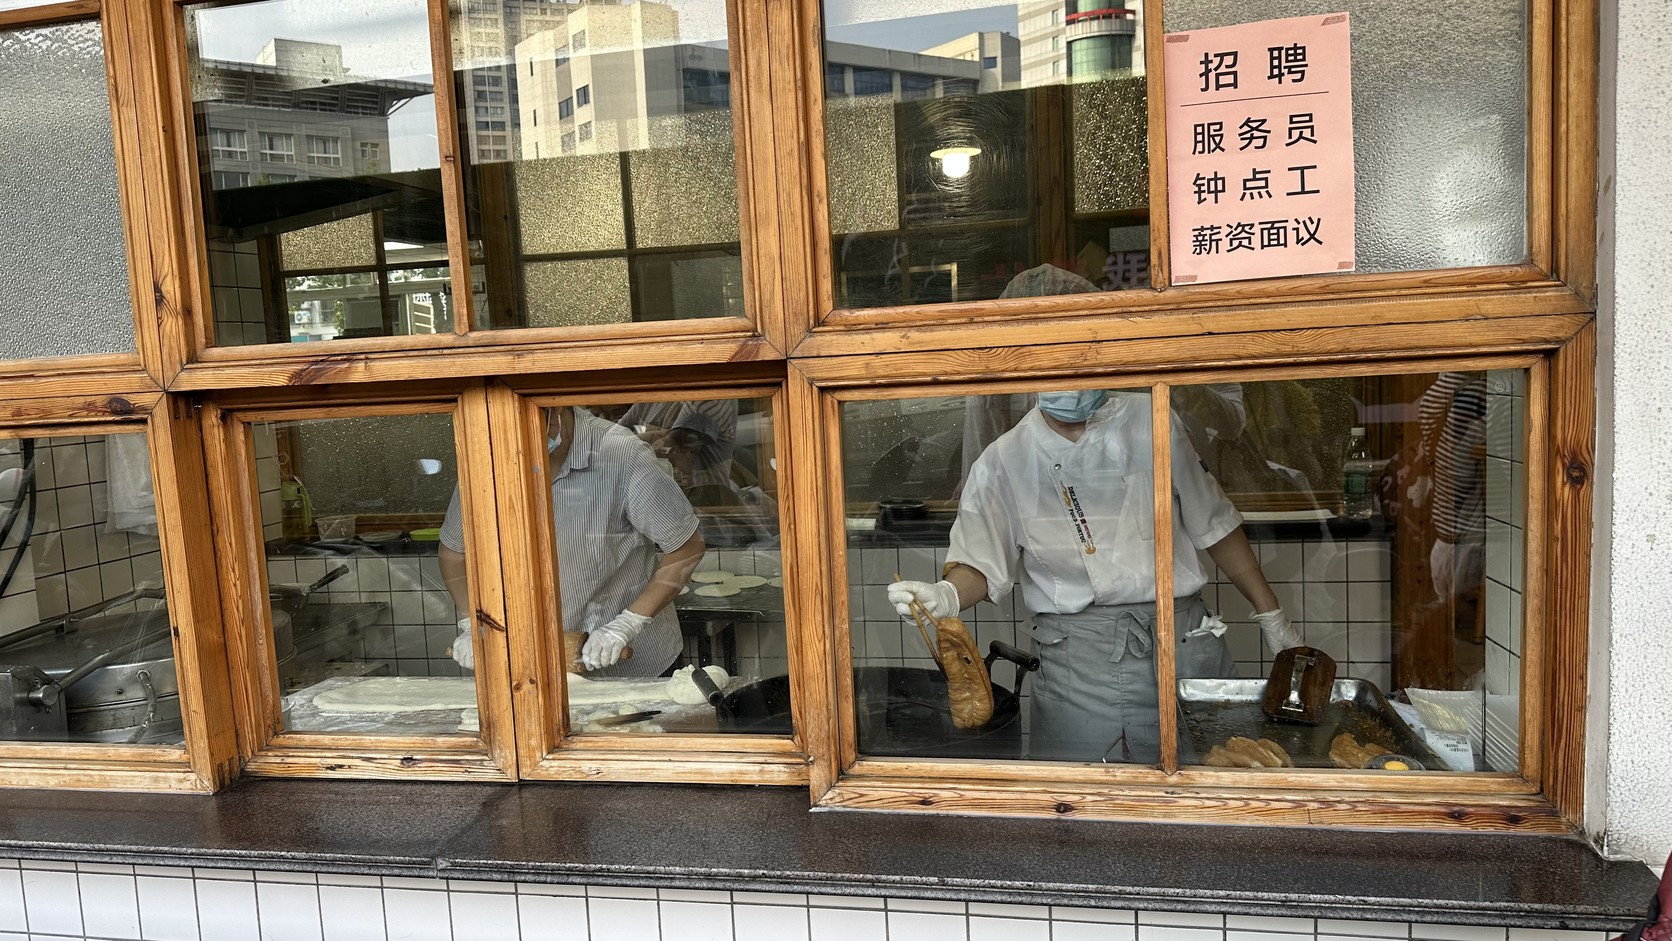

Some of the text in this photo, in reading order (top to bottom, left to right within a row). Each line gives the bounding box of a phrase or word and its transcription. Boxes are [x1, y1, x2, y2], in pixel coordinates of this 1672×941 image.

[1198, 42, 1309, 92] 招聘
[1191, 112, 1318, 156] 服务员
[1192, 164, 1320, 205] 钟点工
[1191, 216, 1323, 256] 薪资面议
[1068, 485, 1085, 518] DELICIOUS
